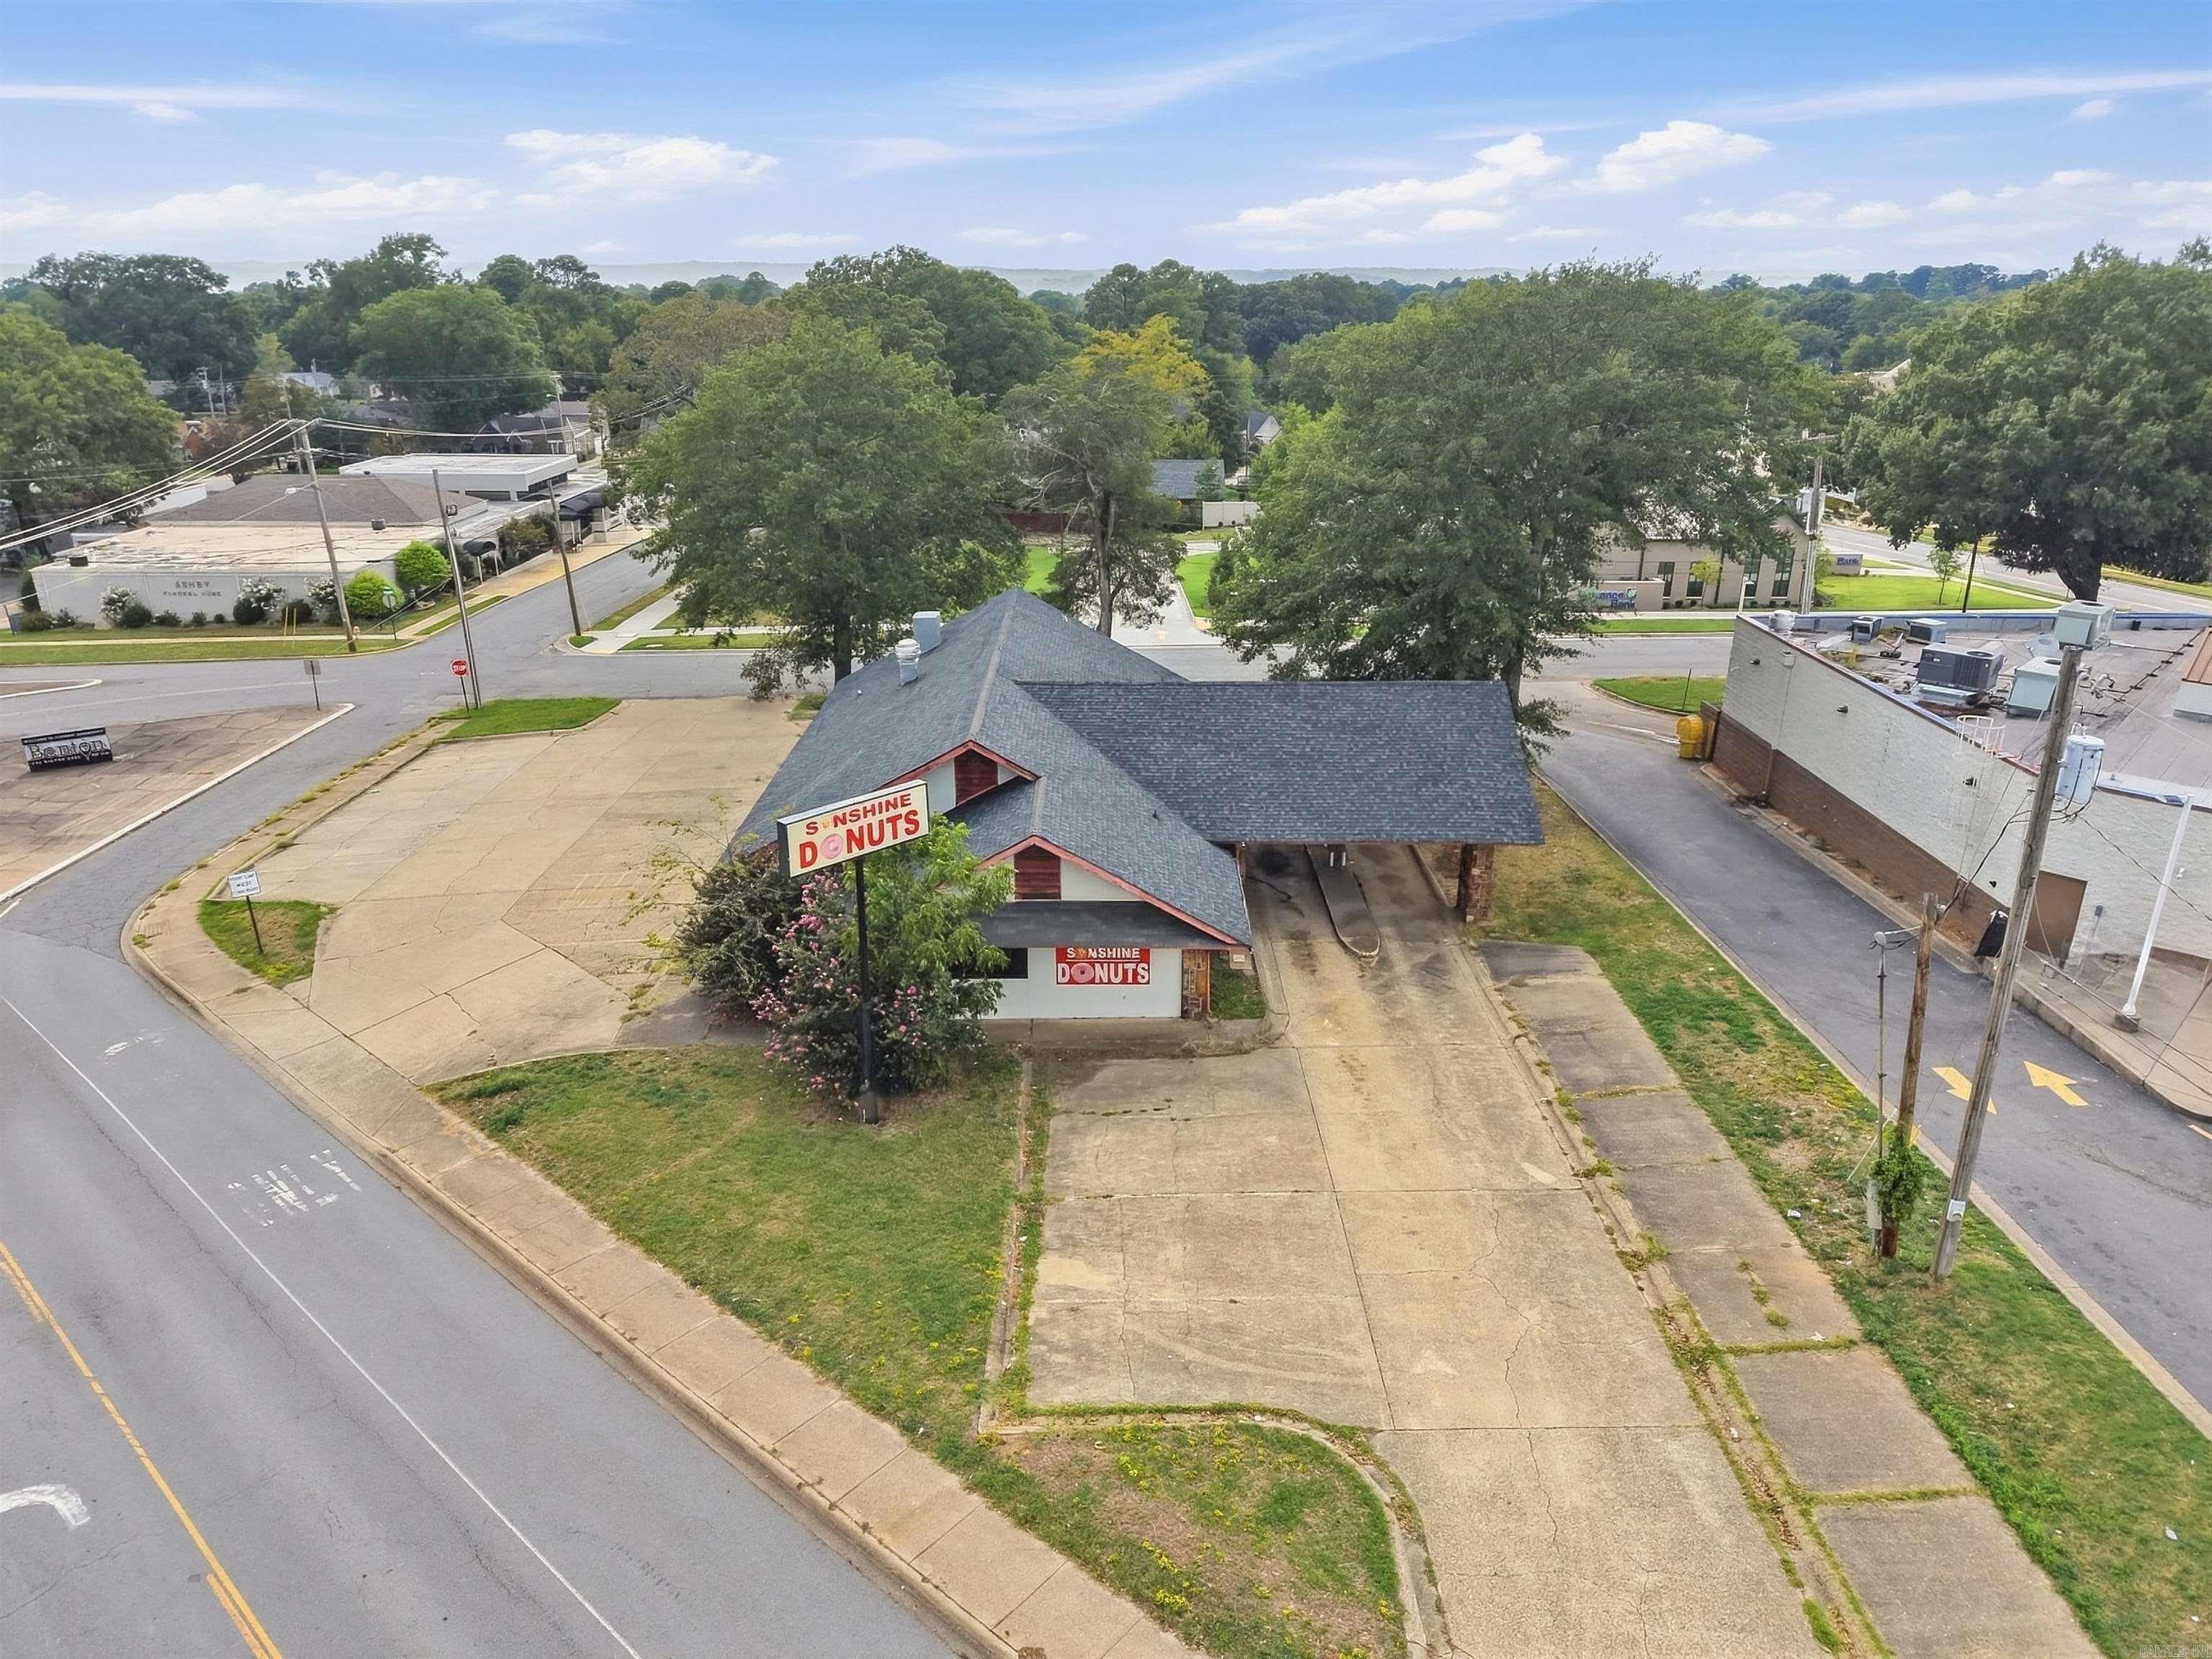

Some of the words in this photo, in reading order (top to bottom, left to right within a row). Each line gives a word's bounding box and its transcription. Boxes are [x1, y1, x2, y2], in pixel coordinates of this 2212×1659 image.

[28, 739, 107, 760] Benton
[806, 793, 912, 835] SNSHINE
[799, 809, 920, 869] DONUTS
[1066, 947, 1140, 958] SNSHINE
[1057, 962, 1150, 984] DONUTS
